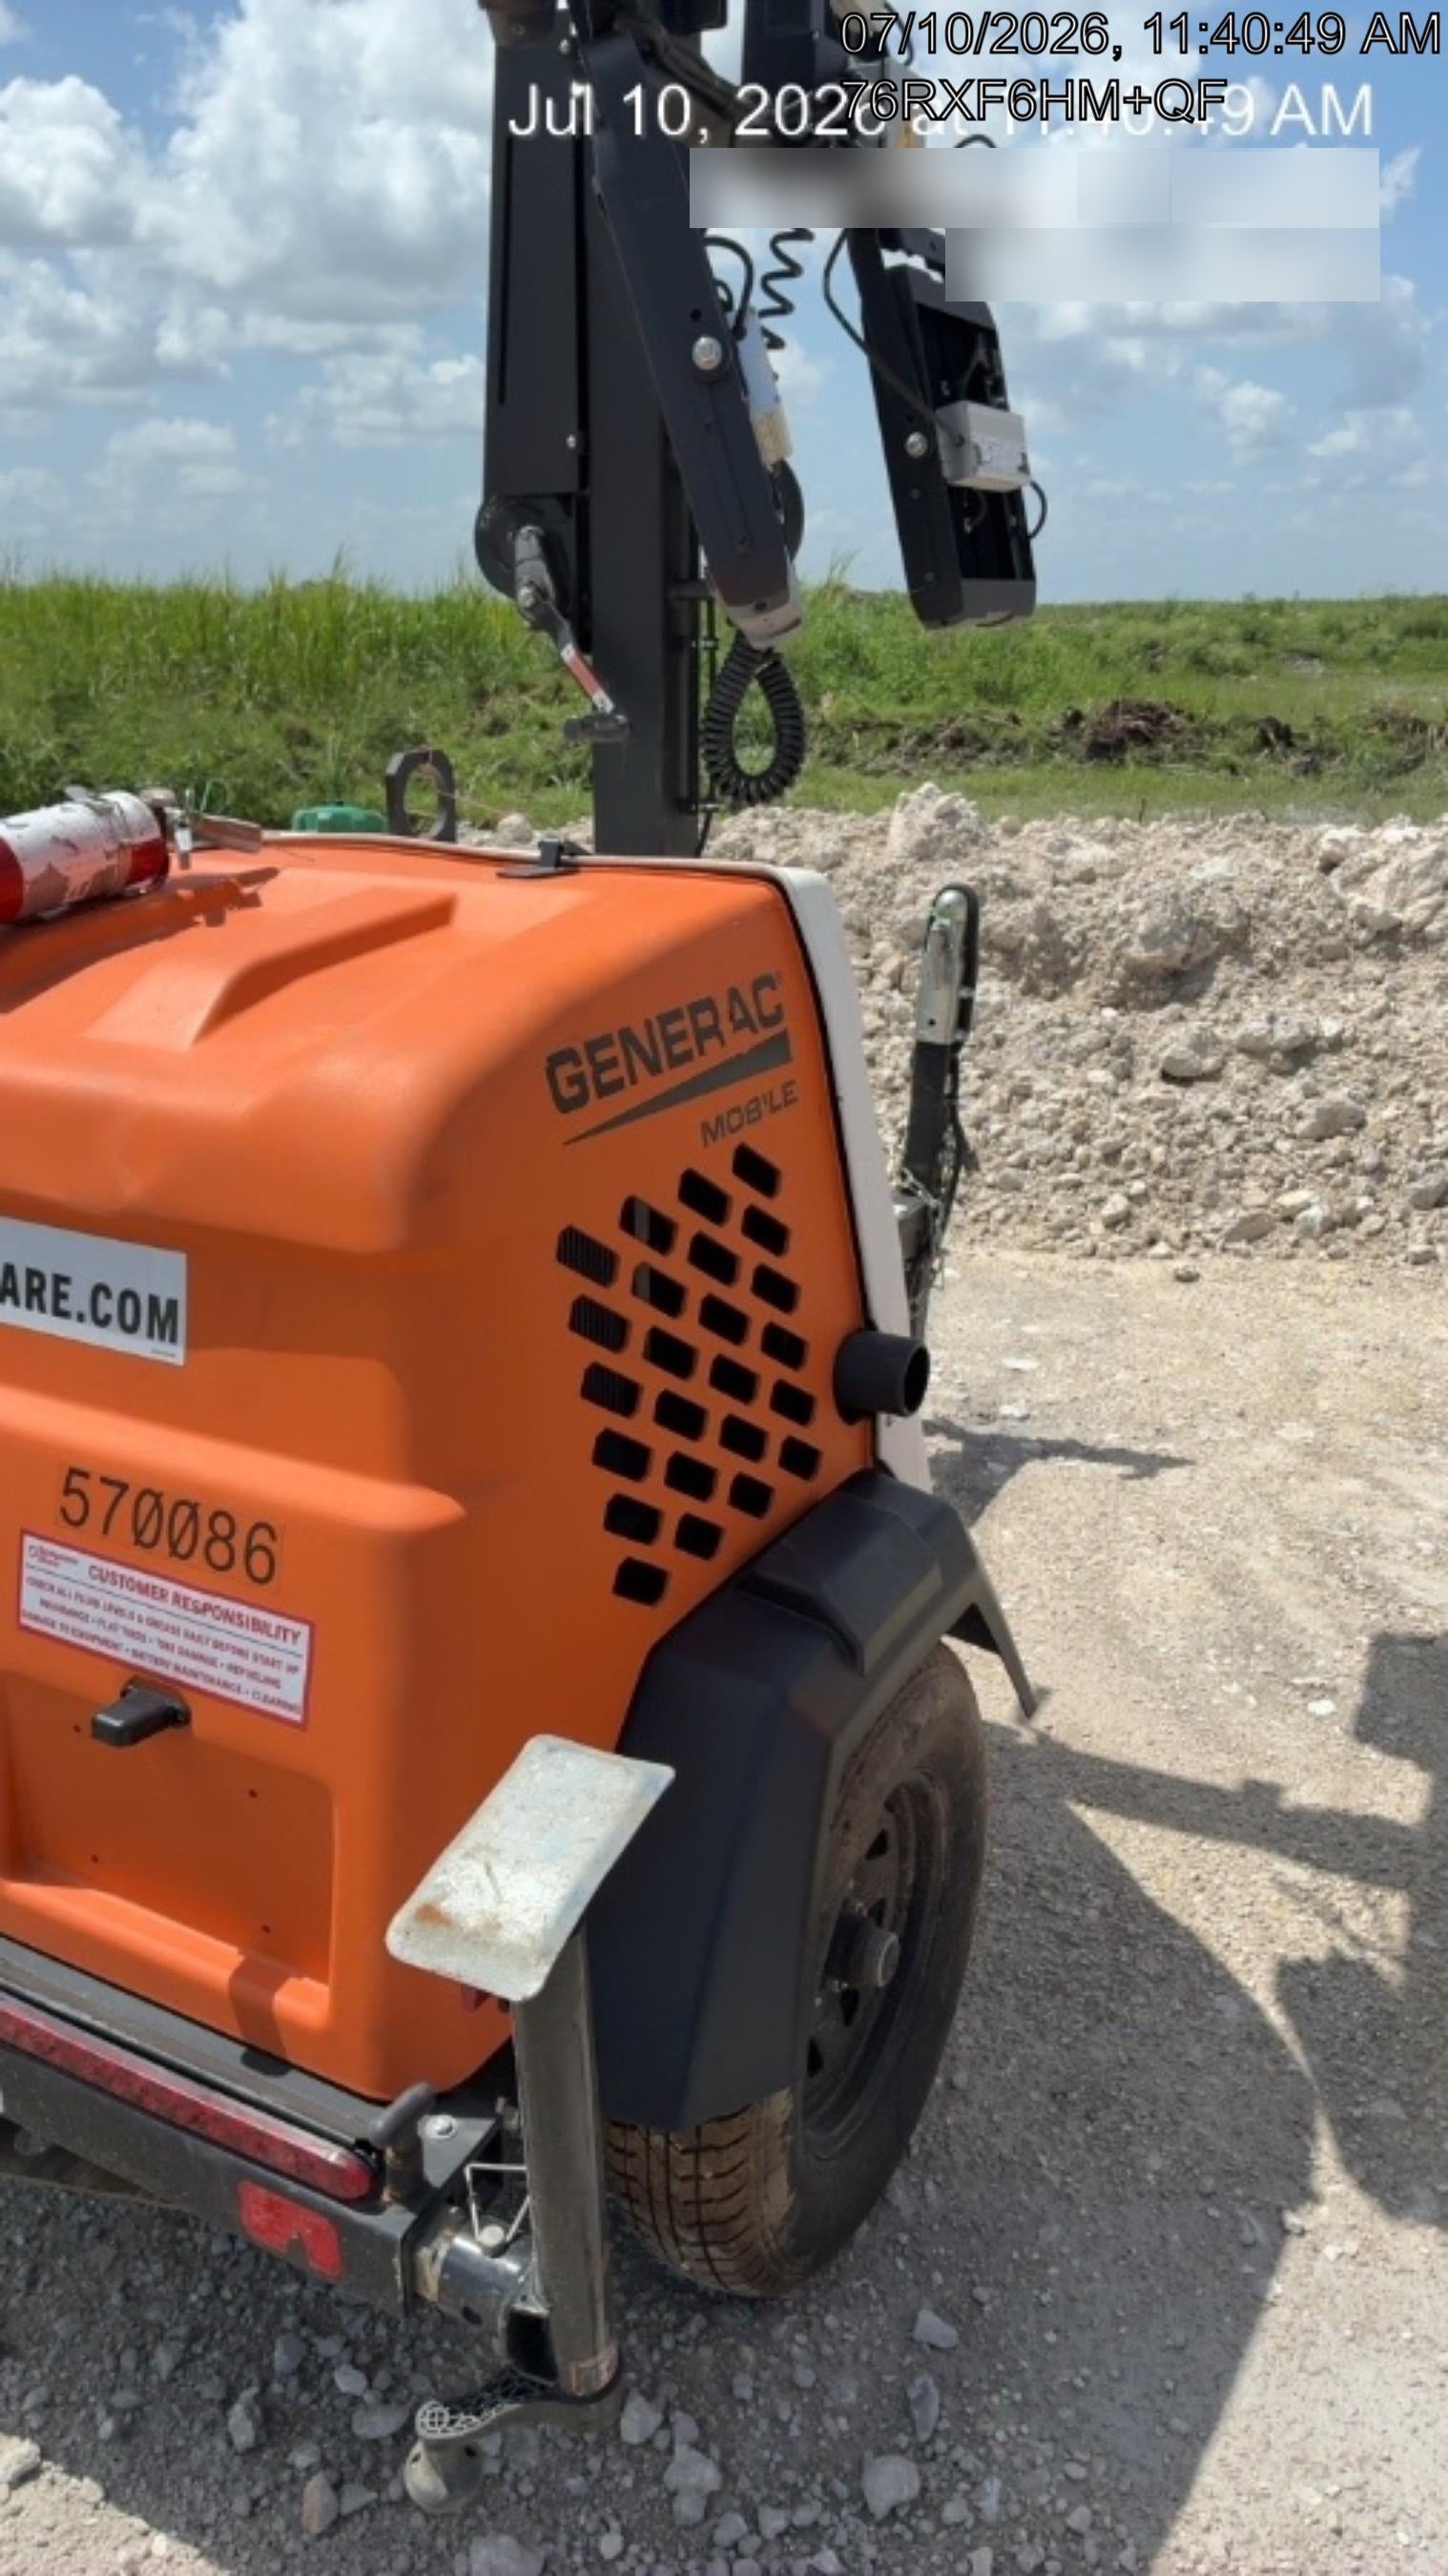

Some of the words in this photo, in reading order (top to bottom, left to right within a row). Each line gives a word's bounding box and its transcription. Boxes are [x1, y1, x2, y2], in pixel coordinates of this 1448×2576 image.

[546, 973, 785, 1114] GENERAC
[699, 1079, 799, 1147] MOBILE
[60, 1467, 278, 1585] 570086
[88, 1564, 167, 1603] CUSTOMER
[172, 1591, 300, 1648] RESPONSIBILITY
